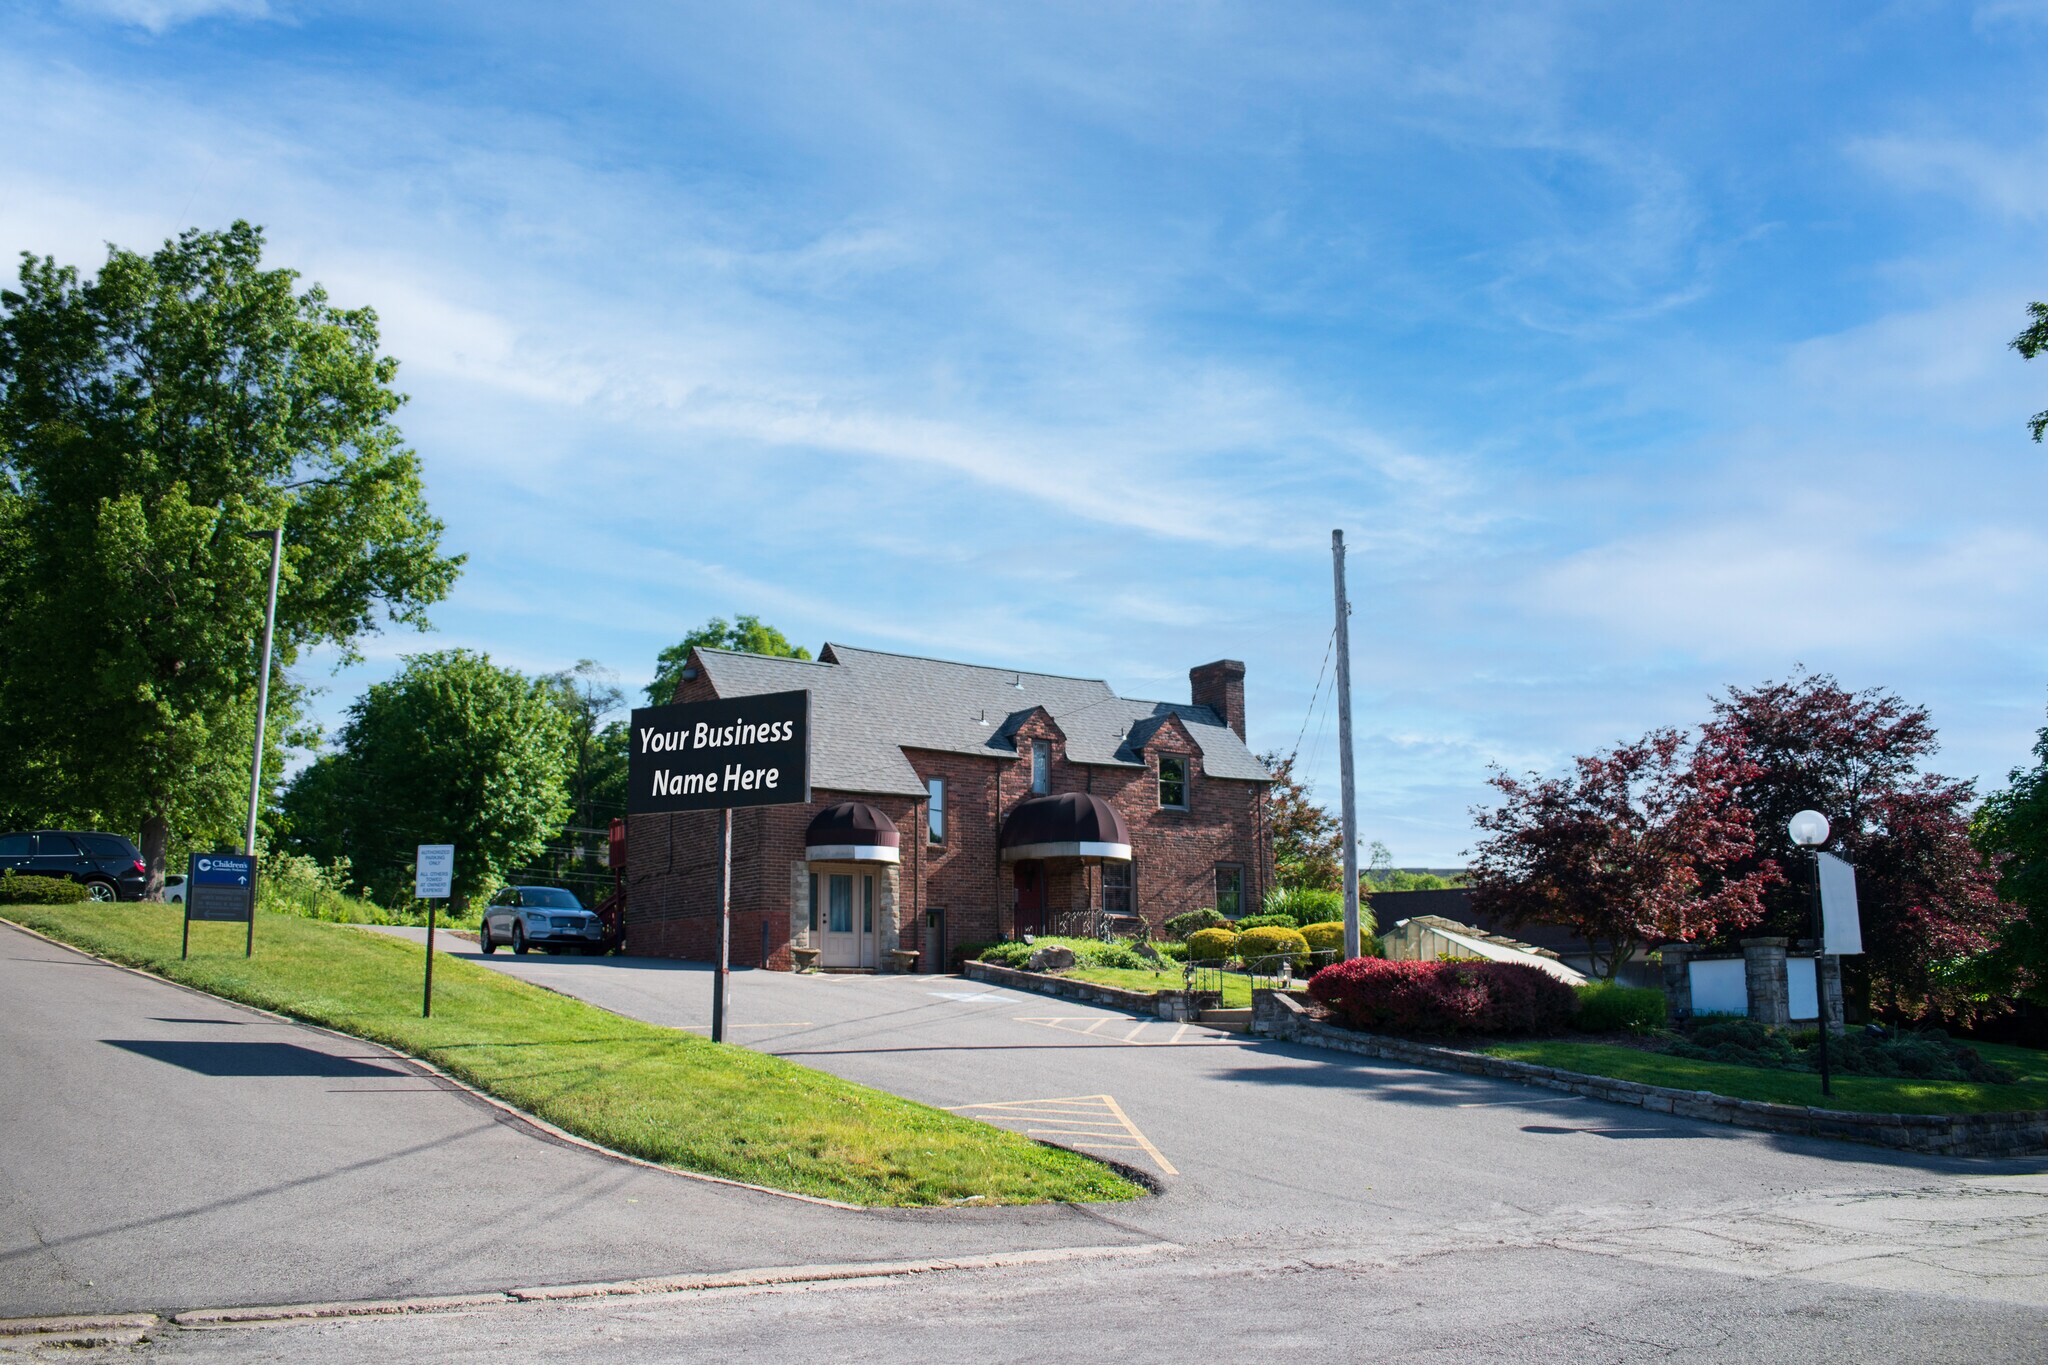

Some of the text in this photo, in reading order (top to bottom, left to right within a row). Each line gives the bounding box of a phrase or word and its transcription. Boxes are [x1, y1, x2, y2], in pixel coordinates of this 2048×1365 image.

[640, 718, 793, 753] Your Business
[652, 763, 779, 796] Name Here
[212, 860, 248, 869] Children's
